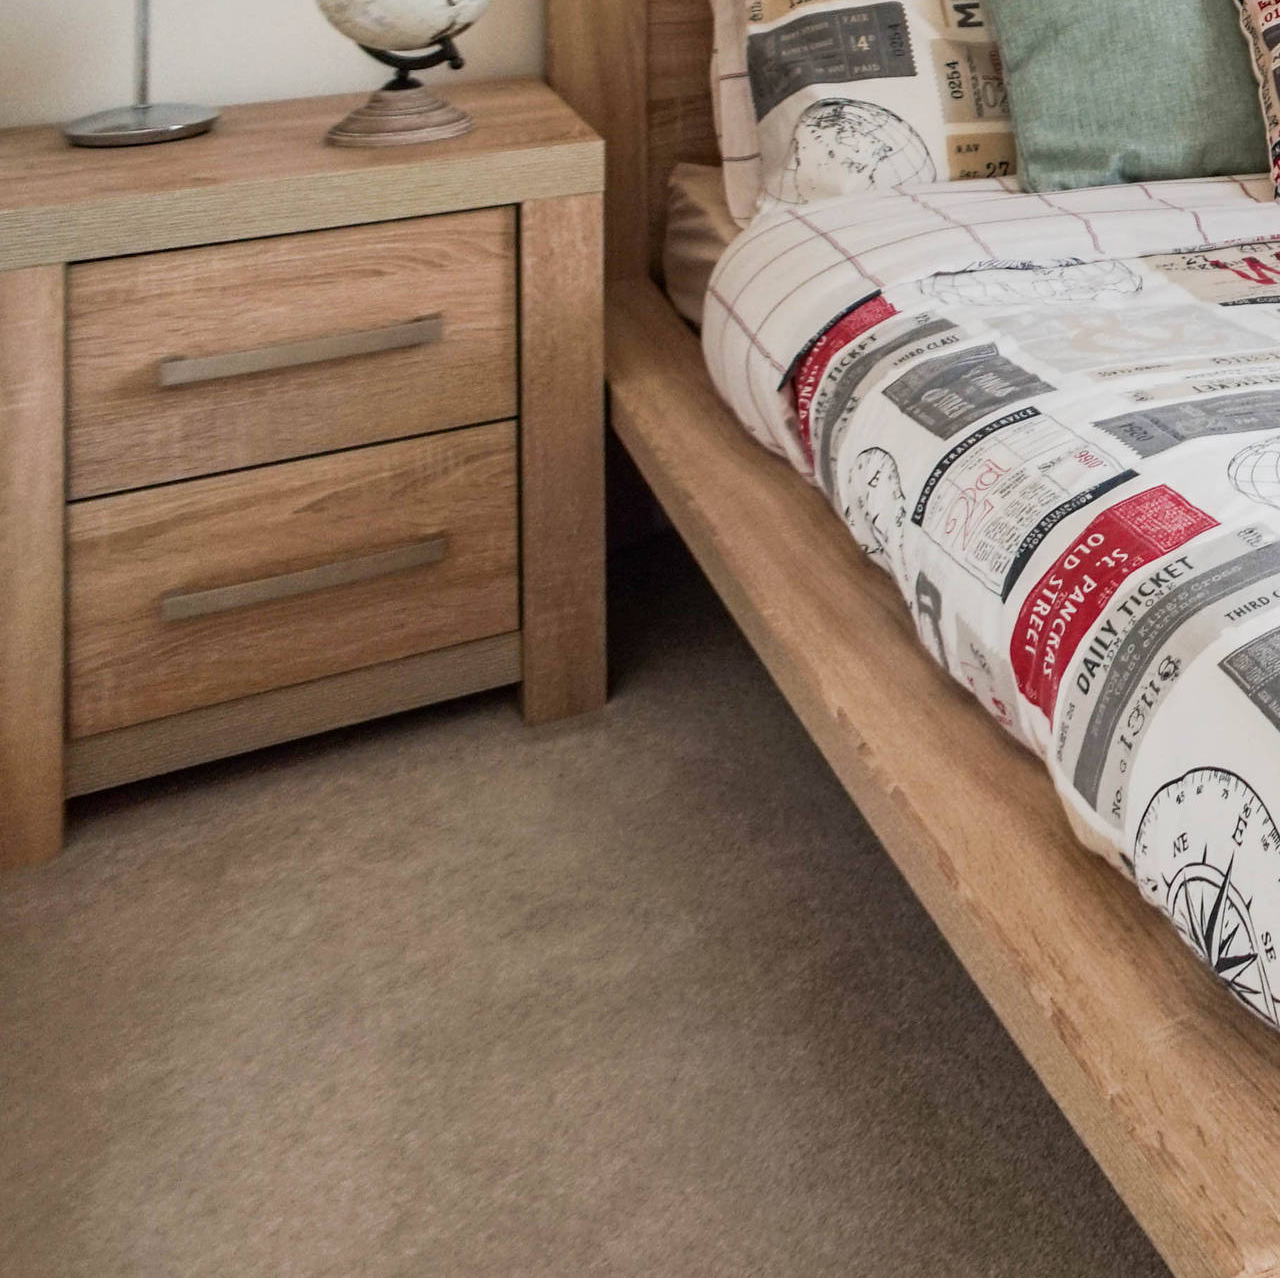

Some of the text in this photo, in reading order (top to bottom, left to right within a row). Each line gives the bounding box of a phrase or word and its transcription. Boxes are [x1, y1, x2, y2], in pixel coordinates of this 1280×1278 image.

[914, 407, 1036, 522] LONDON TRAINS SERVICE
[1062, 532, 1106, 570] OLD
[1096, 548, 1129, 569] St.
[1025, 574, 1065, 654] STREET
[1042, 573, 1099, 678] PANCRAS
[1076, 555, 1195, 696] DAILY TICKET
[1224, 593, 1270, 622] THIRD
